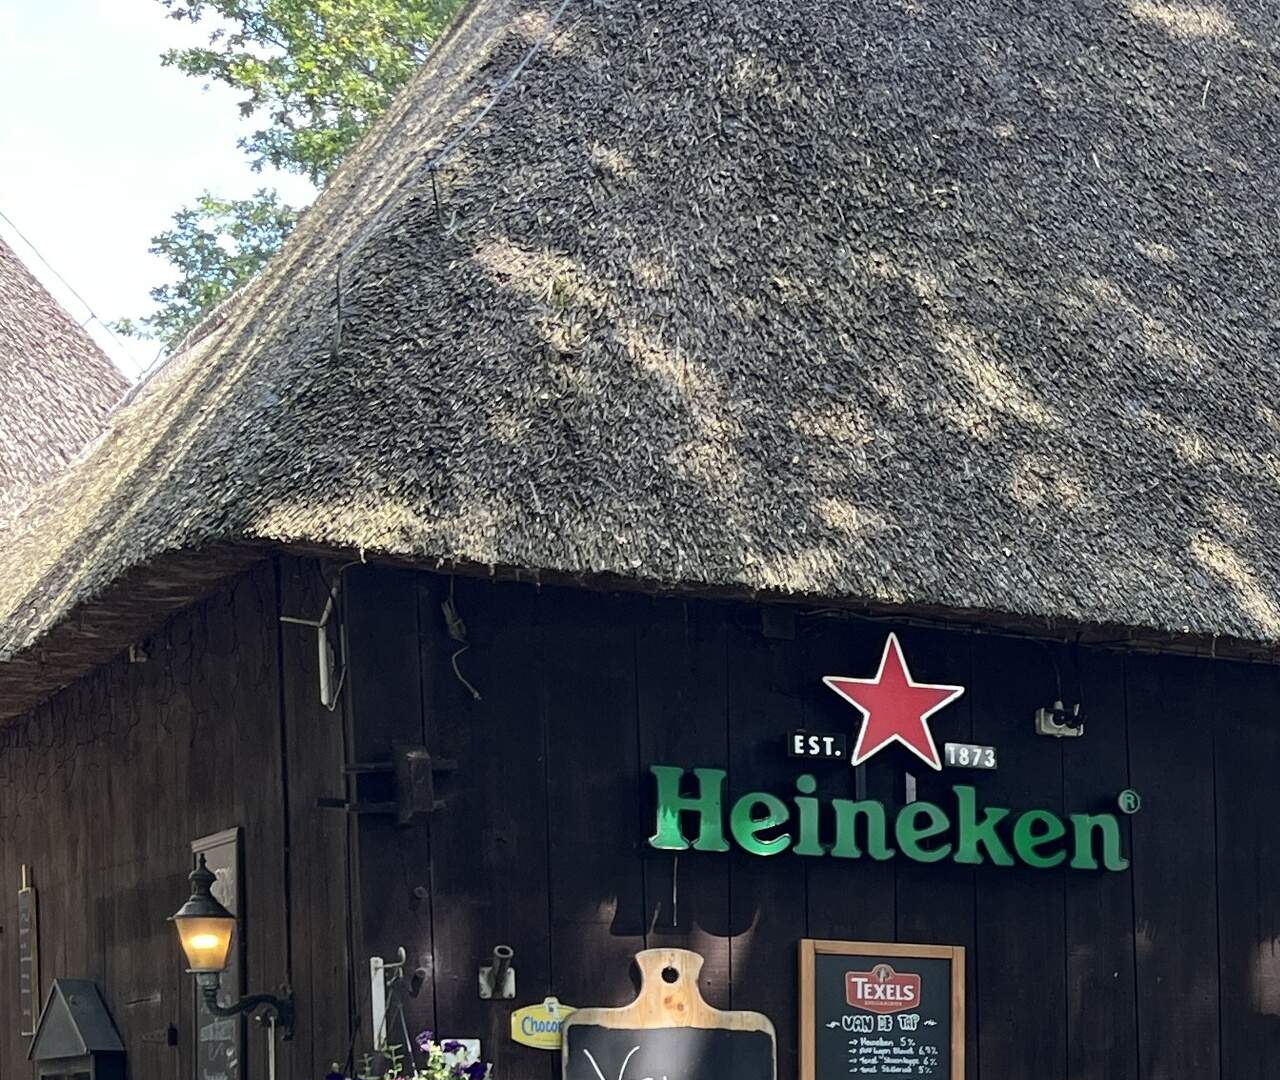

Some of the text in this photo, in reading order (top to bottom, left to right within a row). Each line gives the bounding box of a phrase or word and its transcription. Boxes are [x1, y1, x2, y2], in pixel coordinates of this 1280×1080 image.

[793, 734, 842, 757] EST.
[947, 745, 996, 768] 1873
[648, 764, 1131, 872] Heineken
[850, 977, 915, 1001] TEXELS
[842, 1013, 920, 1033] VAN DE TAP
